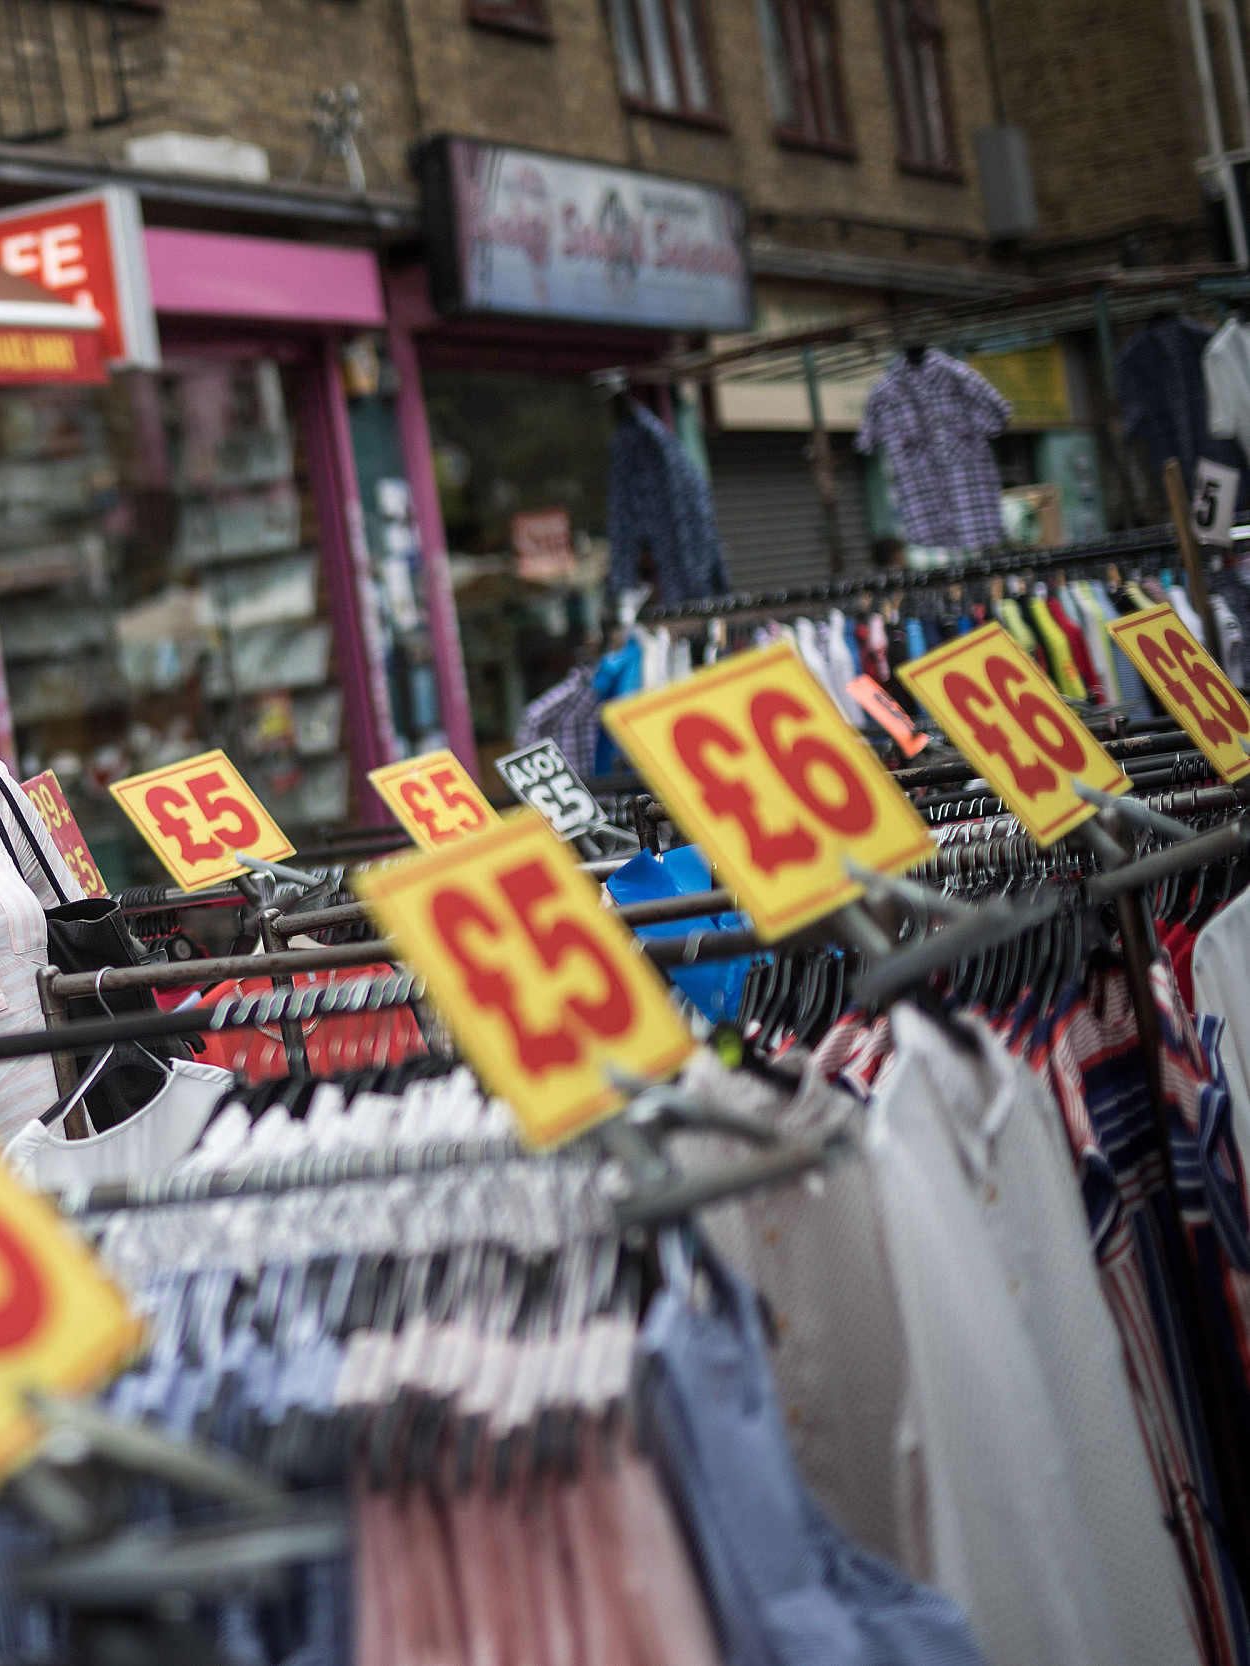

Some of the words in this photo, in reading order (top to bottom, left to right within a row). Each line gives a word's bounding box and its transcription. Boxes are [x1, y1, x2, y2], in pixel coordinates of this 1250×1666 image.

[942, 655, 1087, 799] £6
[1136, 628, 1249, 748] £6
[144, 771, 261, 866] £5
[399, 767, 488, 845] £5
[509, 744, 565, 790] ASOS
[528, 771, 596, 833] £5
[670, 687, 878, 877] £6
[427, 858, 637, 1080] £5
